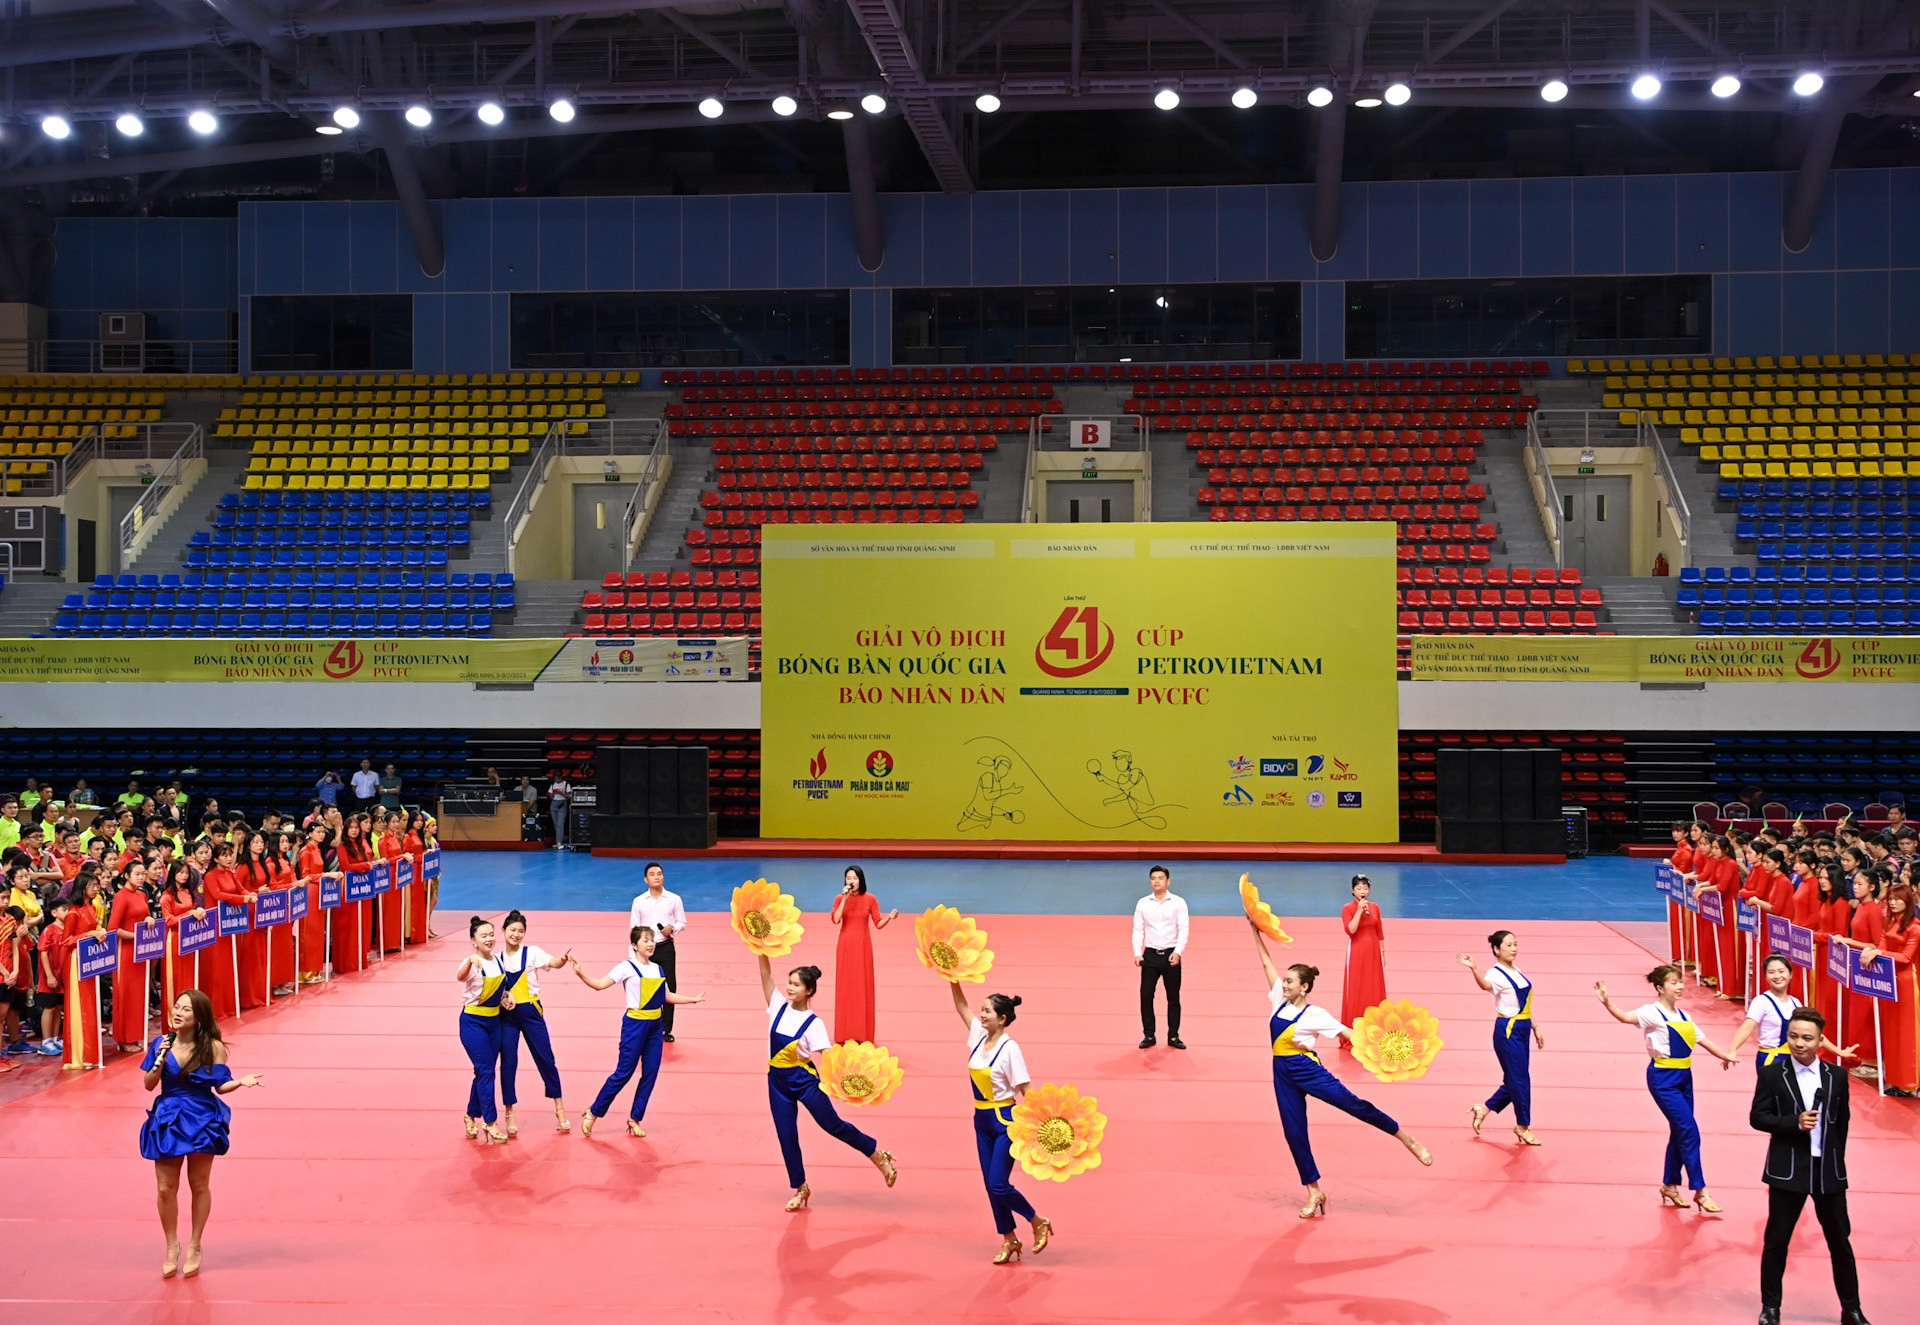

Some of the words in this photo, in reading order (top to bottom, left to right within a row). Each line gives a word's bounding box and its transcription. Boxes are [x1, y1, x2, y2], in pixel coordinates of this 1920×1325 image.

[1082, 424, 1099, 444] B
[856, 624, 902, 647] GIẢI
[911, 626, 942, 647] VÔ
[950, 630, 1005, 650] ĐỊCH
[1137, 625, 1184, 646] CÚP
[235, 641, 260, 652] GIẢI
[264, 642, 278, 652] VÔ
[374, 640, 398, 652] CÚP
[1696, 639, 1723, 650] GIẢI
[1728, 640, 1746, 650] VÔ
[1852, 639, 1880, 650] CÚP
[194, 653, 227, 665] BÓNG
[231, 653, 254, 665] BÀN
[258, 652, 292, 666] QUỐC
[294, 655, 314, 665] GIA
[374, 655, 469, 664] PETROVIETNAM
[1650, 652, 1686, 664] BÓNG
[1691, 652, 1716, 664] BÀN
[1721, 652, 1757, 665] QUỐC
[1762, 654, 1784, 664] GIA
[778, 653, 839, 674] BÓNG
[848, 653, 891, 674] BÀN
[900, 652, 961, 677] QUỐC
[968, 657, 1007, 674] GIA
[1137, 657, 1322, 674] PETROVIETNAM
[225, 666, 248, 677] BÁO
[252, 666, 285, 677] NHÂN
[289, 666, 313, 677] DÂN
[374, 668, 411, 677] PVCFC
[1686, 665, 1711, 676] BÁO
[1716, 666, 1752, 676] NHÂN
[1758, 666, 1784, 676] DÂN
[1852, 667, 1896, 677] PVCFC
[840, 683, 883, 704] BÁO
[891, 684, 952, 704] NHÂN
[961, 684, 1005, 704] DÂN
[1137, 687, 1210, 704] PVCFC
[1263, 764, 1286, 773] BIDV
[793, 780, 843, 789] PETROVIETNAM
[850, 780, 868, 791] PHÂN
[870, 780, 883, 791] BÓN
[885, 780, 893, 791] CÀ
[895, 782, 909, 791] MAU
[808, 790, 828, 799] PVCFC
[351, 886, 359, 895] HÀ
[360, 884, 371, 895] NỘI
[263, 895, 280, 908] ĐOÀN
[105, 955, 115, 966] NINH
[1854, 973, 1871, 989] VĨNH
[1872, 979, 1892, 993] LONG
